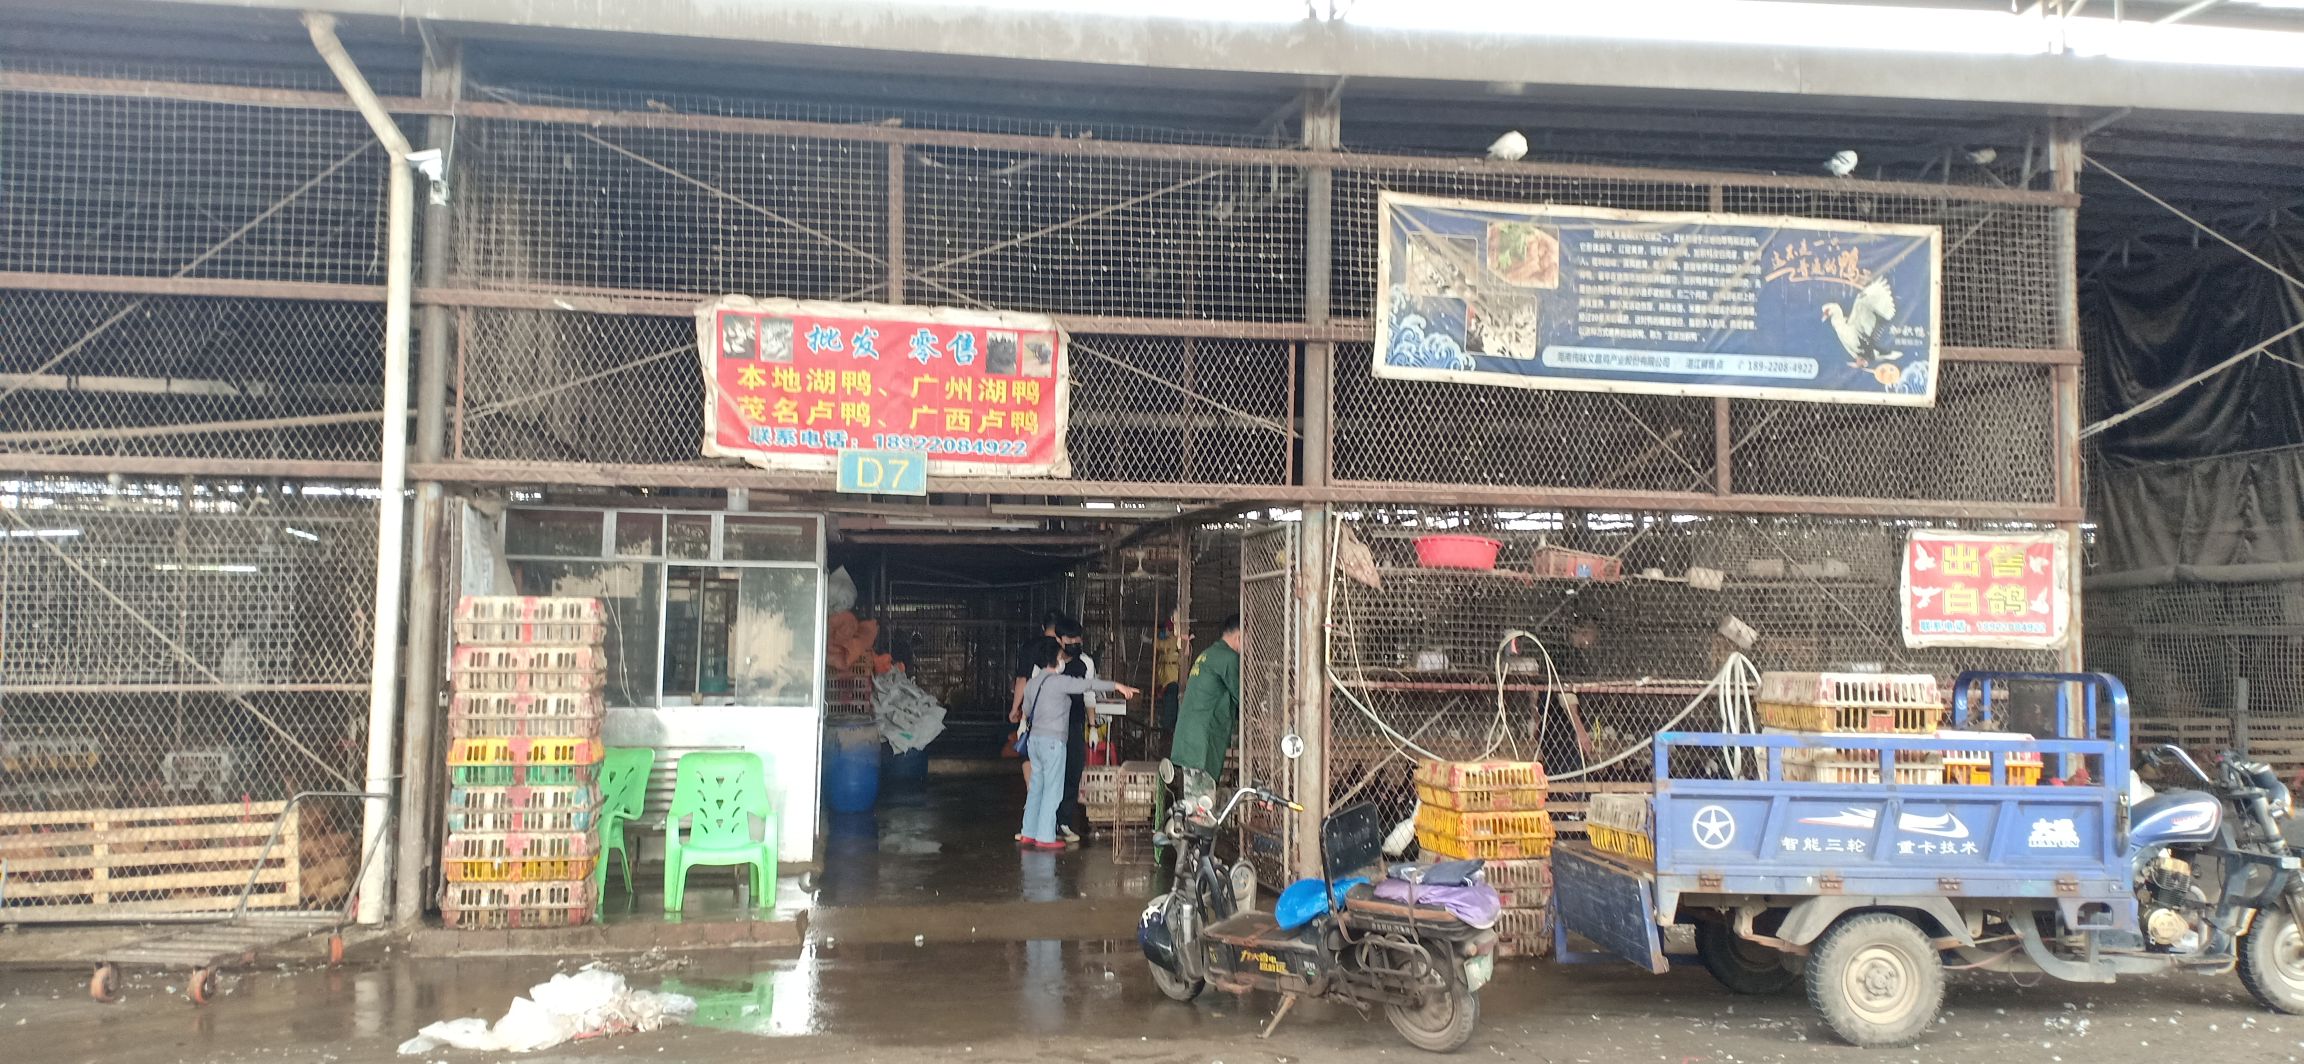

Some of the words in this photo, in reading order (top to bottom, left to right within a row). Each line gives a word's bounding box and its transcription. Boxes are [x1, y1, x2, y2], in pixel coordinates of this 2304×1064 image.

[805, 325, 880, 360] 批发
[908, 328, 979, 366] 零售
[855, 457, 910, 489] D7
[1941, 543, 2026, 577] 出售
[1942, 581, 2028, 616] 白鸽
[1780, 836, 1867, 854] 智能三轮
[1896, 839, 1980, 856] 重卡技术
